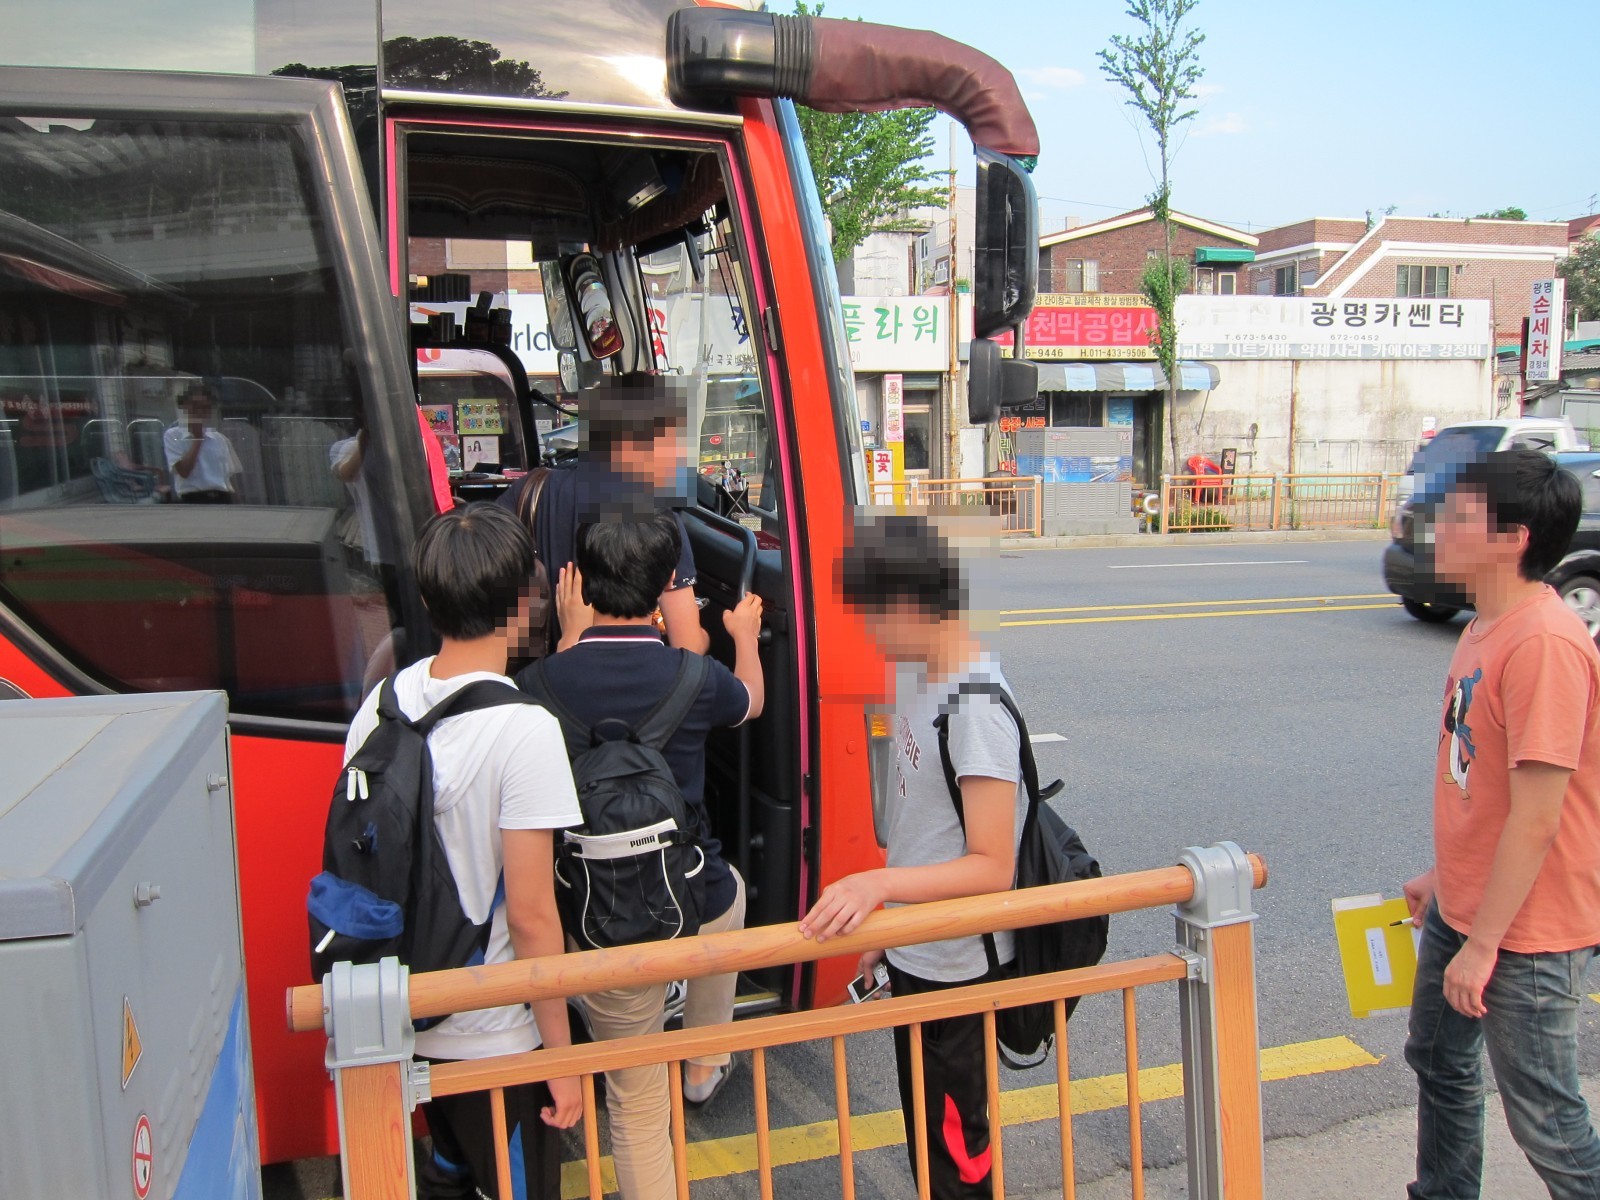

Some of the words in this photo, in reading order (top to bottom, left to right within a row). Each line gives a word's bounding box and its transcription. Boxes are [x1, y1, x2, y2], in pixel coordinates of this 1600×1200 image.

[1533, 282, 1552, 294] 광명
[1044, 296, 1071, 306] 간이창고
[841, 304, 938, 344] 플라워
[1310, 301, 1464, 328] 광명카쎈타
[1016, 311, 1159, 342] 천막공업사
[1531, 295, 1550, 357] 손세차
[514, 324, 551, 351] rld
[1001, 348, 1063, 358] T.6-9446
[1178, 343, 1215, 358] 교환
[1300, 343, 1362, 358] 악세사리
[875, 452, 890, 473] 꽃
[629, 834, 656, 848] PUMA
